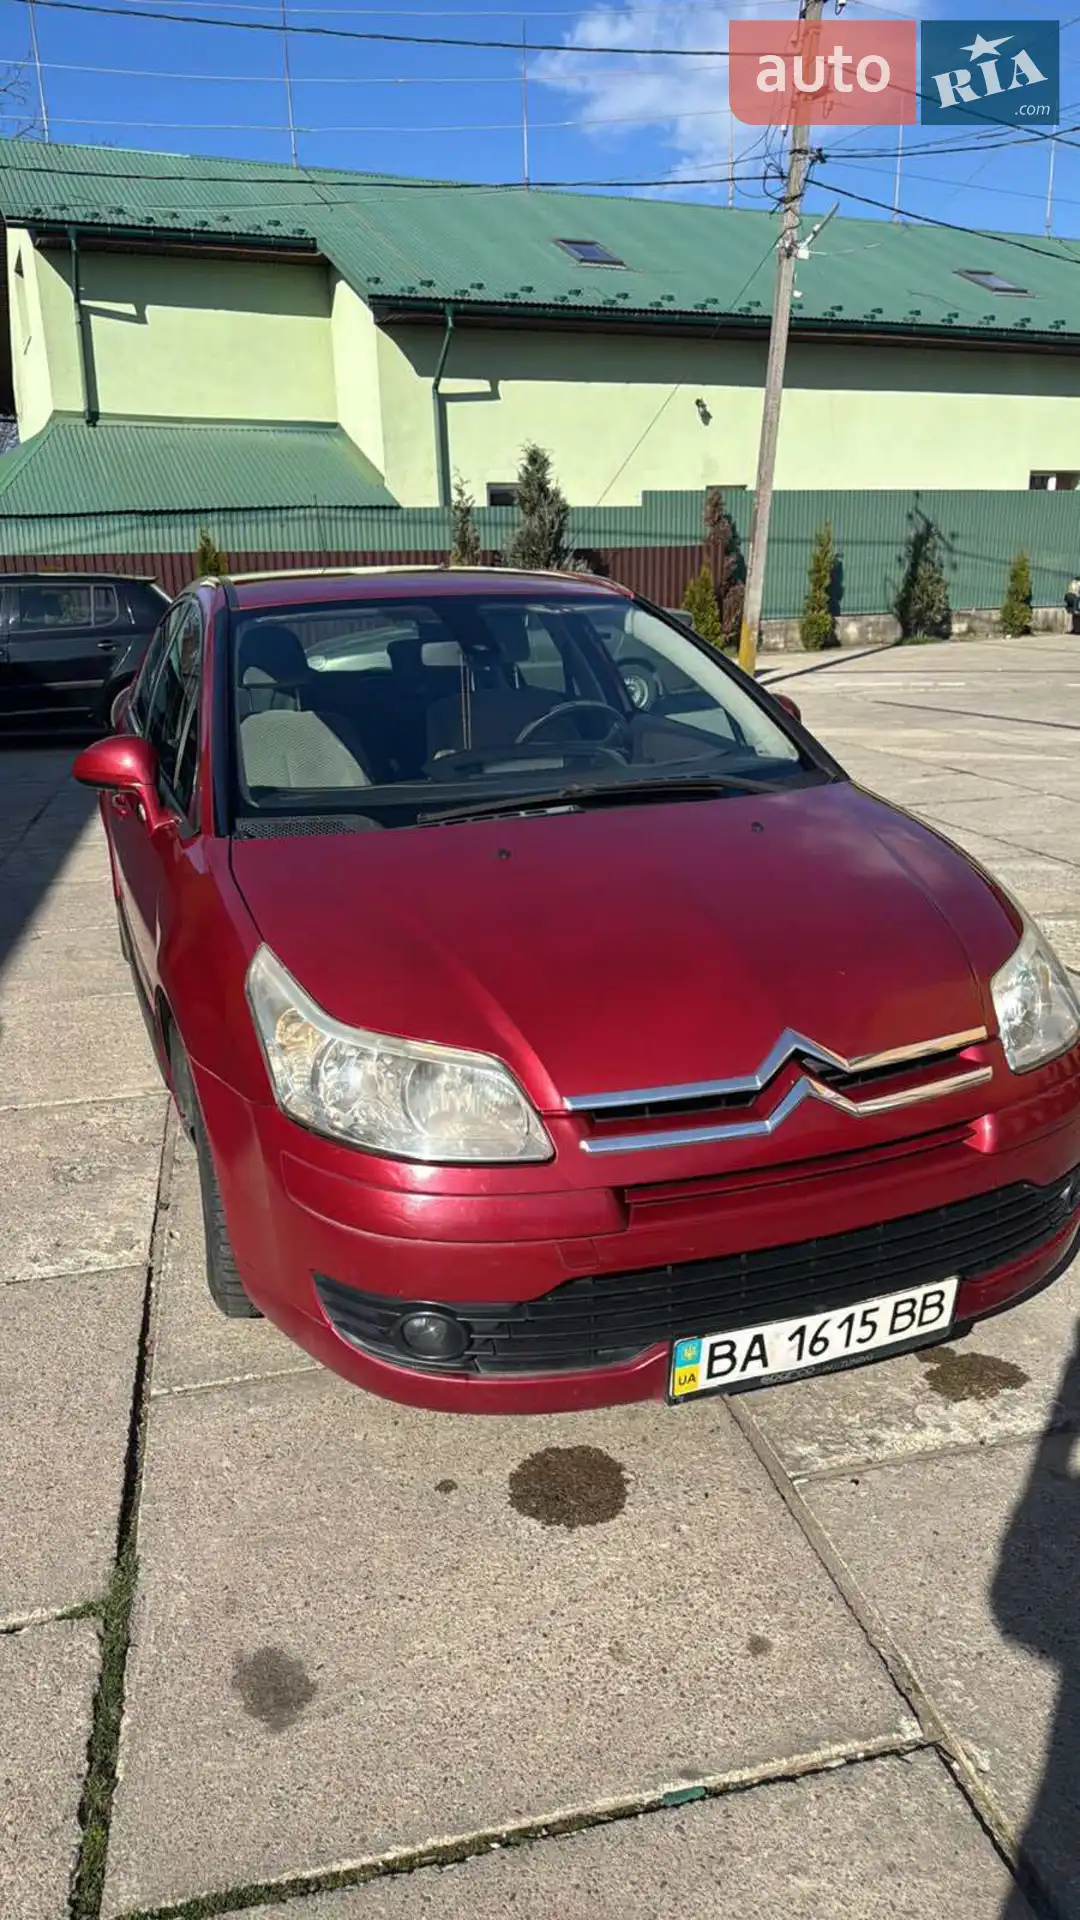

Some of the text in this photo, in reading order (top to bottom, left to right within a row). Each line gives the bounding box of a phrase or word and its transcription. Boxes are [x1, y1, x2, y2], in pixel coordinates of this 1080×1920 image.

[706, 1333, 769, 1379] BA
[788, 1307, 880, 1361] 1615
[889, 1289, 945, 1336] BB
[678, 1371, 697, 1387] UA
